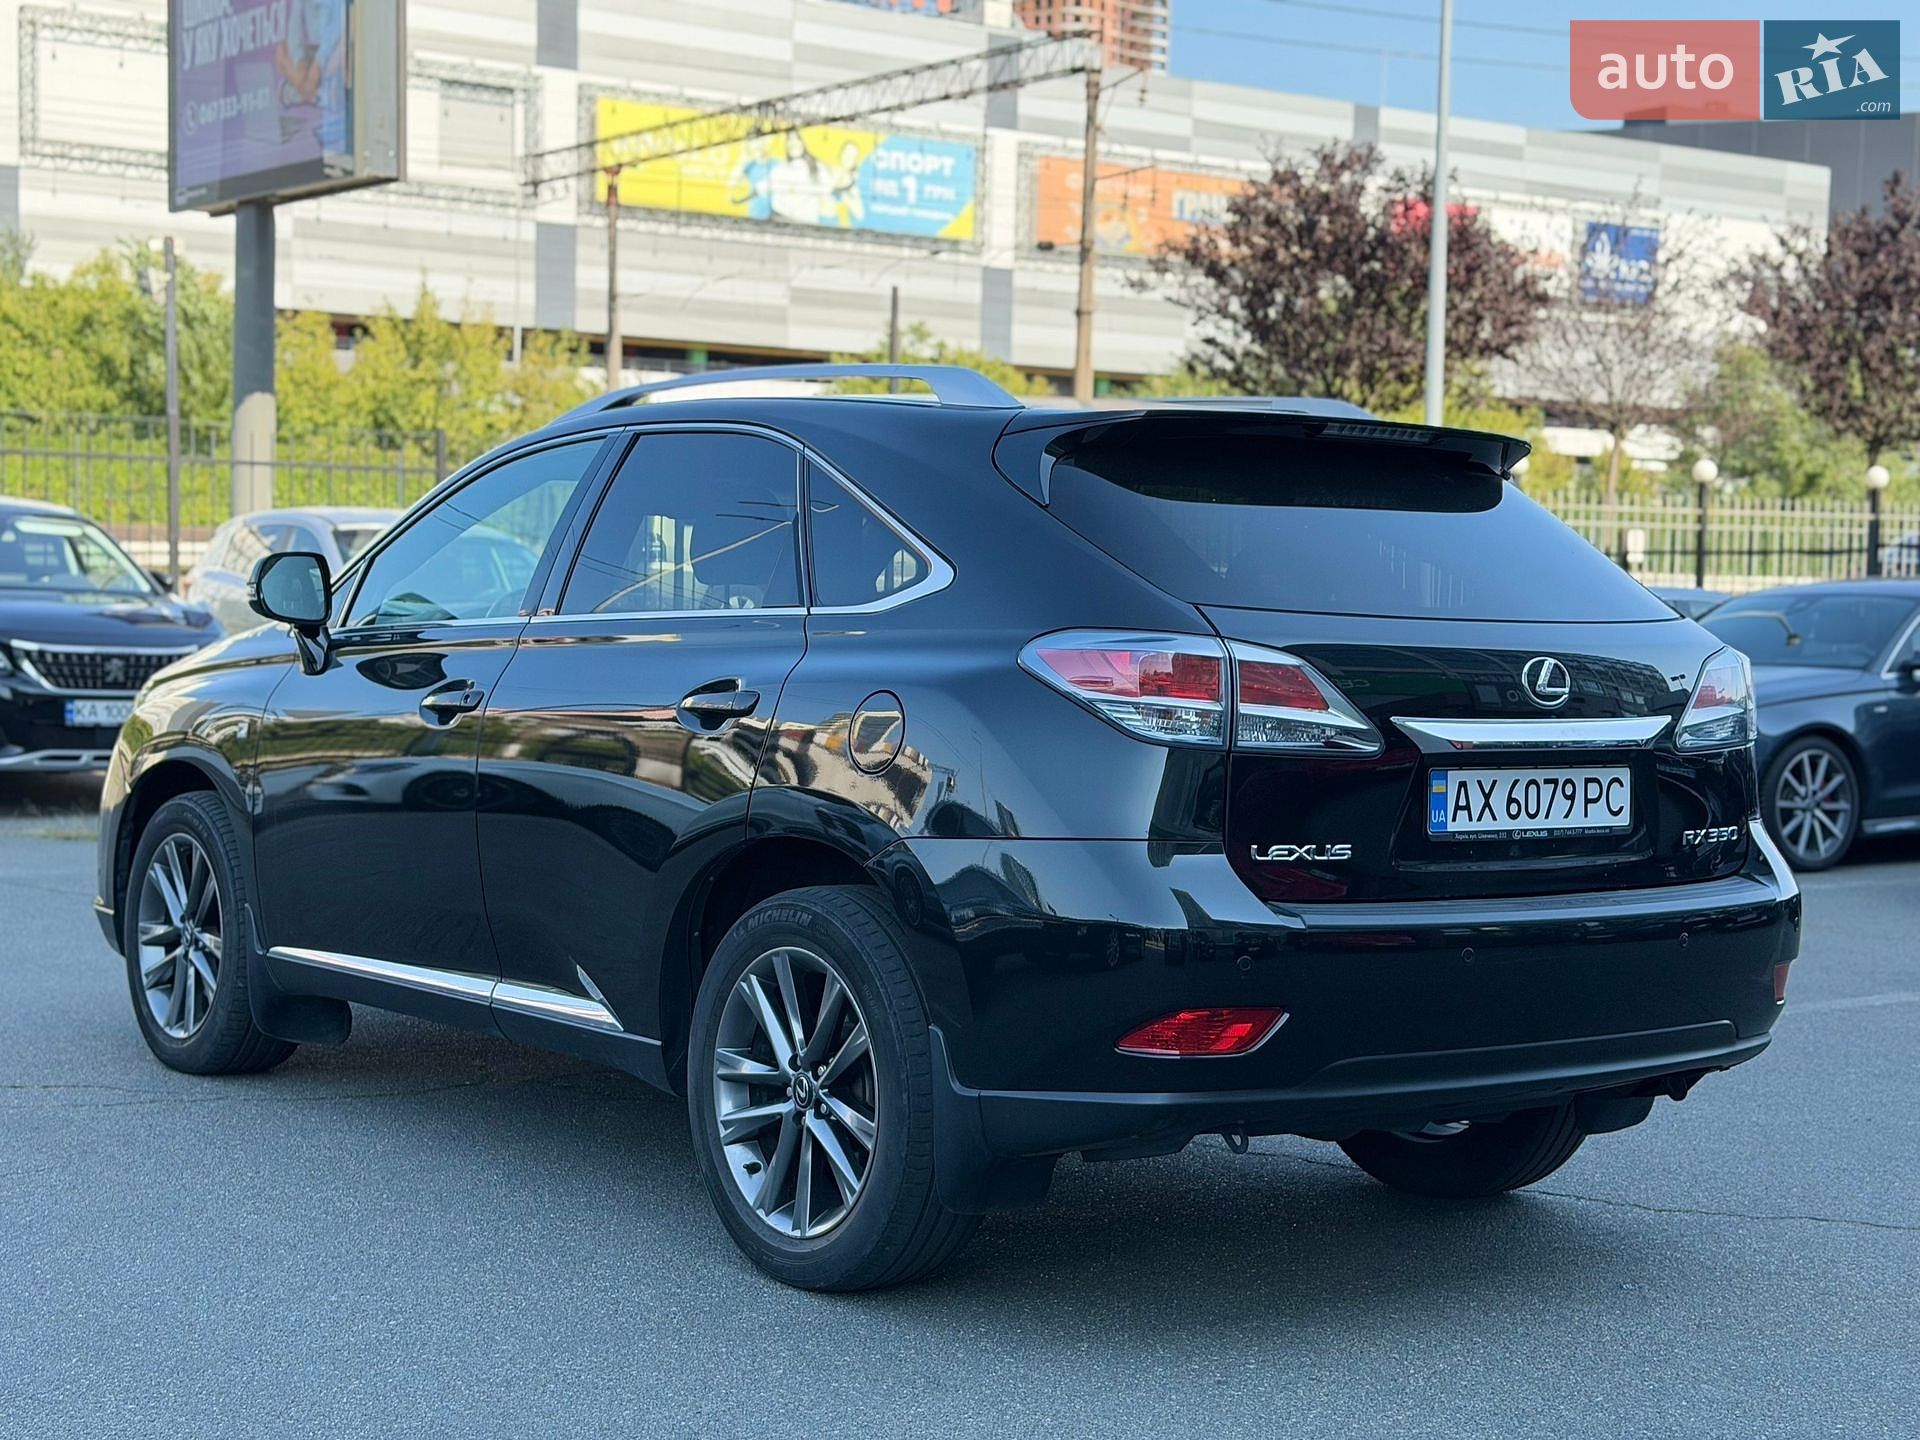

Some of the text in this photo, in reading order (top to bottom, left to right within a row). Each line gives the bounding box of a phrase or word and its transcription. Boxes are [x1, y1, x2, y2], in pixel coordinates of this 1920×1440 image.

[874, 148, 956, 178] СПОРТ
[901, 176, 917, 205] 1
[1451, 776, 1625, 823] AX 6079 PC
[1431, 811, 1446, 823] UA
[1522, 830, 1548, 838] LEXUS
[1250, 844, 1352, 860] LEXUS
[747, 908, 812, 931] MICHELIN
